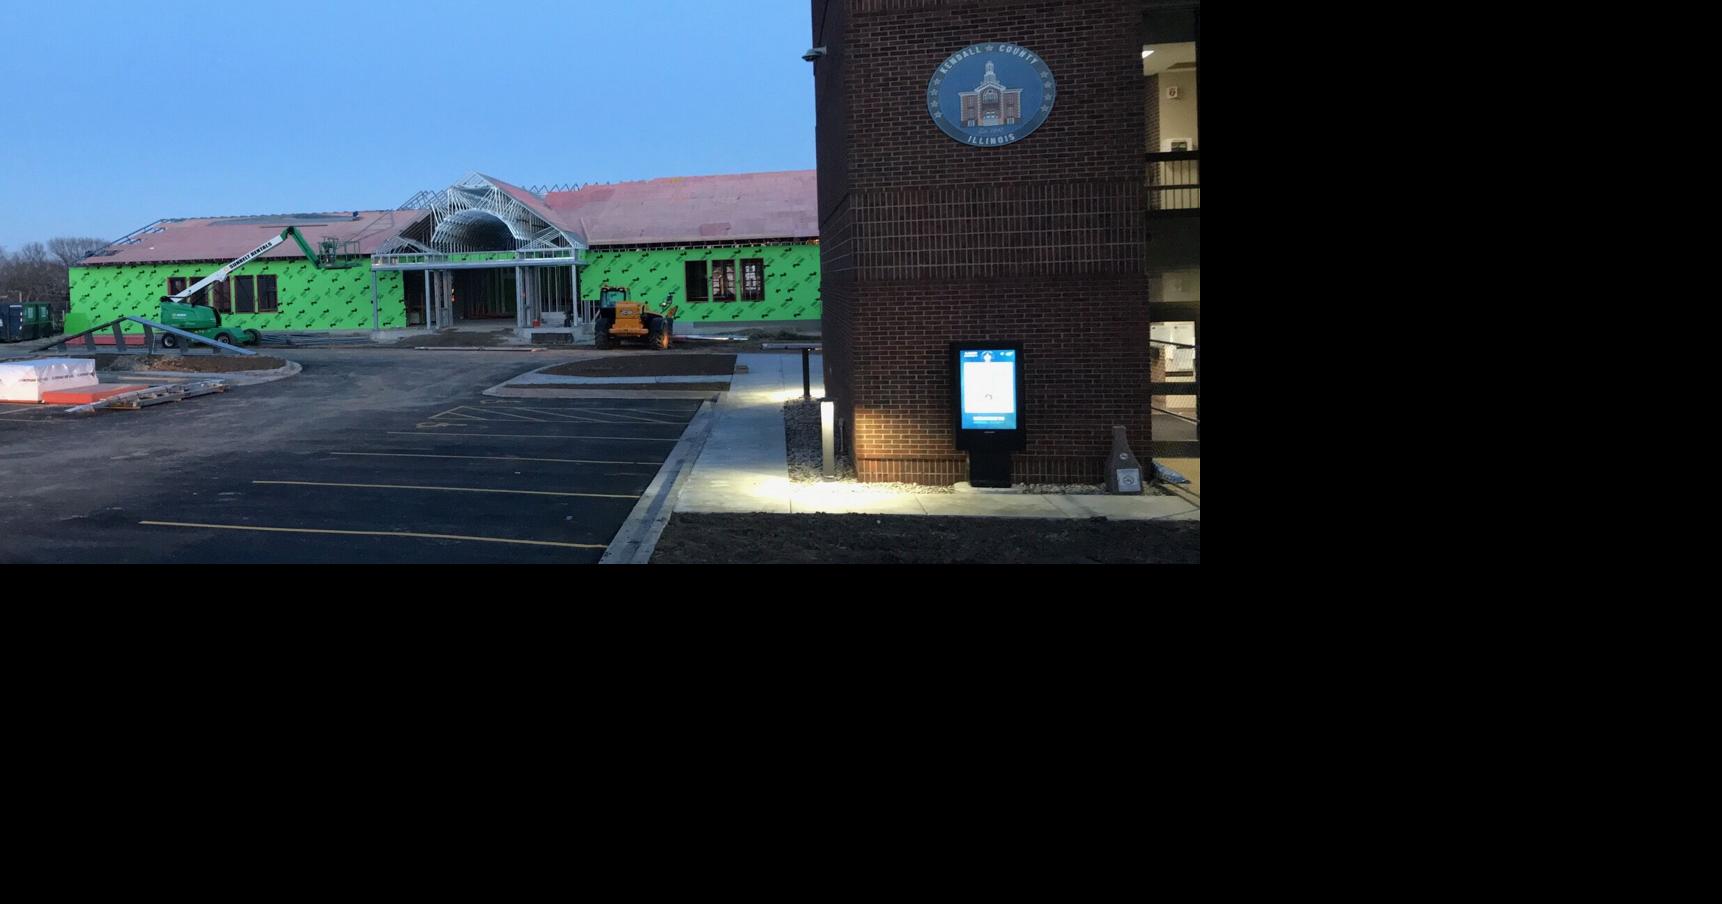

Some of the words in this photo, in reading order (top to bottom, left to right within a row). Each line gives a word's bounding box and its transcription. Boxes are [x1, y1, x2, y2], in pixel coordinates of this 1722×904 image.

[940, 46, 982, 74] KENDALL
[998, 44, 1040, 65] COUNTY
[967, 133, 1016, 145] ILLINOIS
[250, 241, 273, 257] RENTALS
